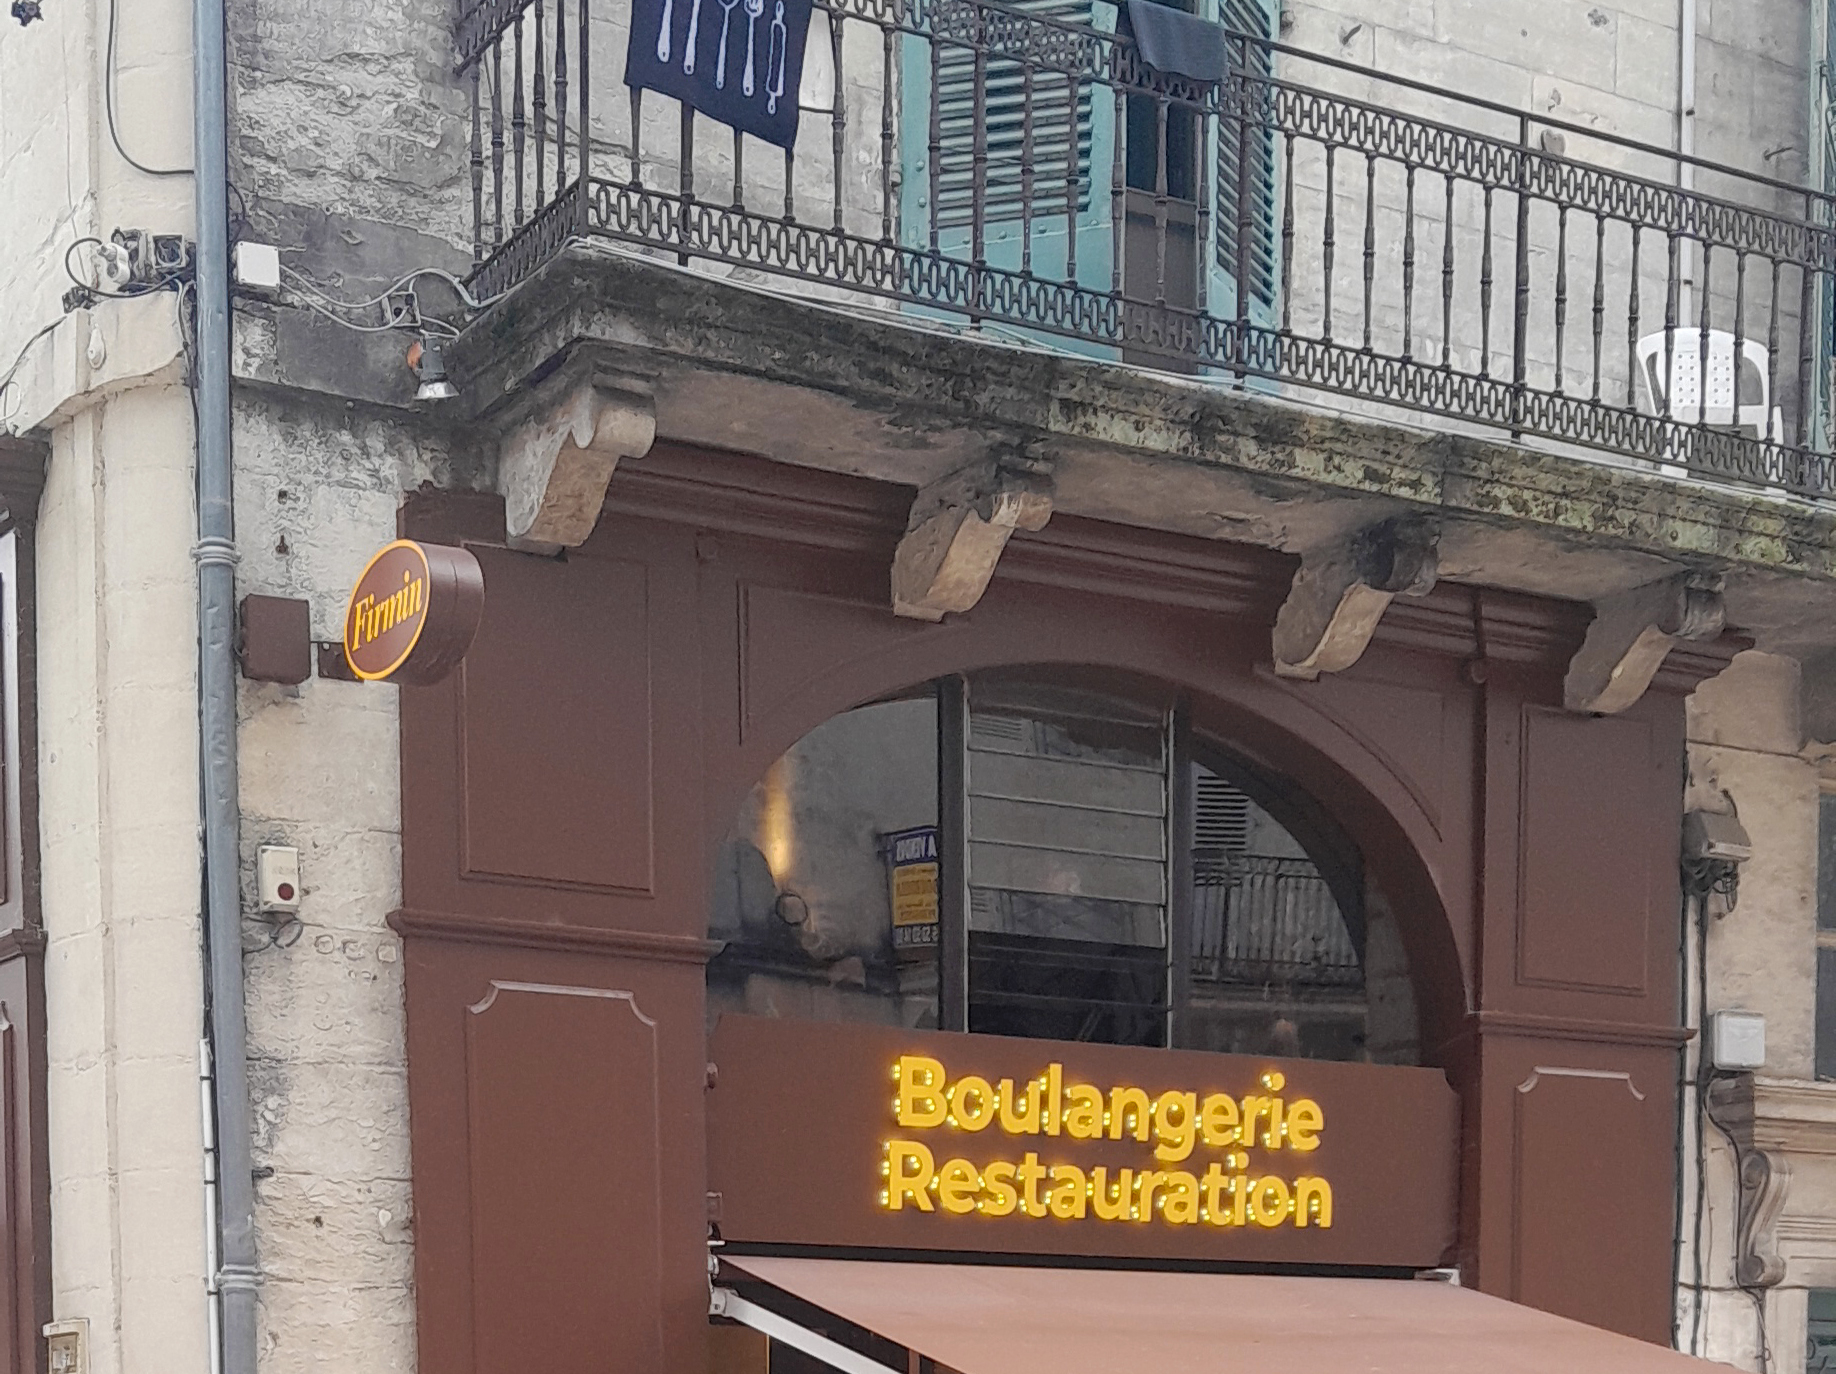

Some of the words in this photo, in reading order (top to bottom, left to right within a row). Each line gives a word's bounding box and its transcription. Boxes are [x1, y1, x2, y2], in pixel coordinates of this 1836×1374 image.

[351, 569, 423, 652] Firmin
[893, 1055, 1325, 1162] Boulangerie
[881, 1139, 1333, 1228] Restauration
